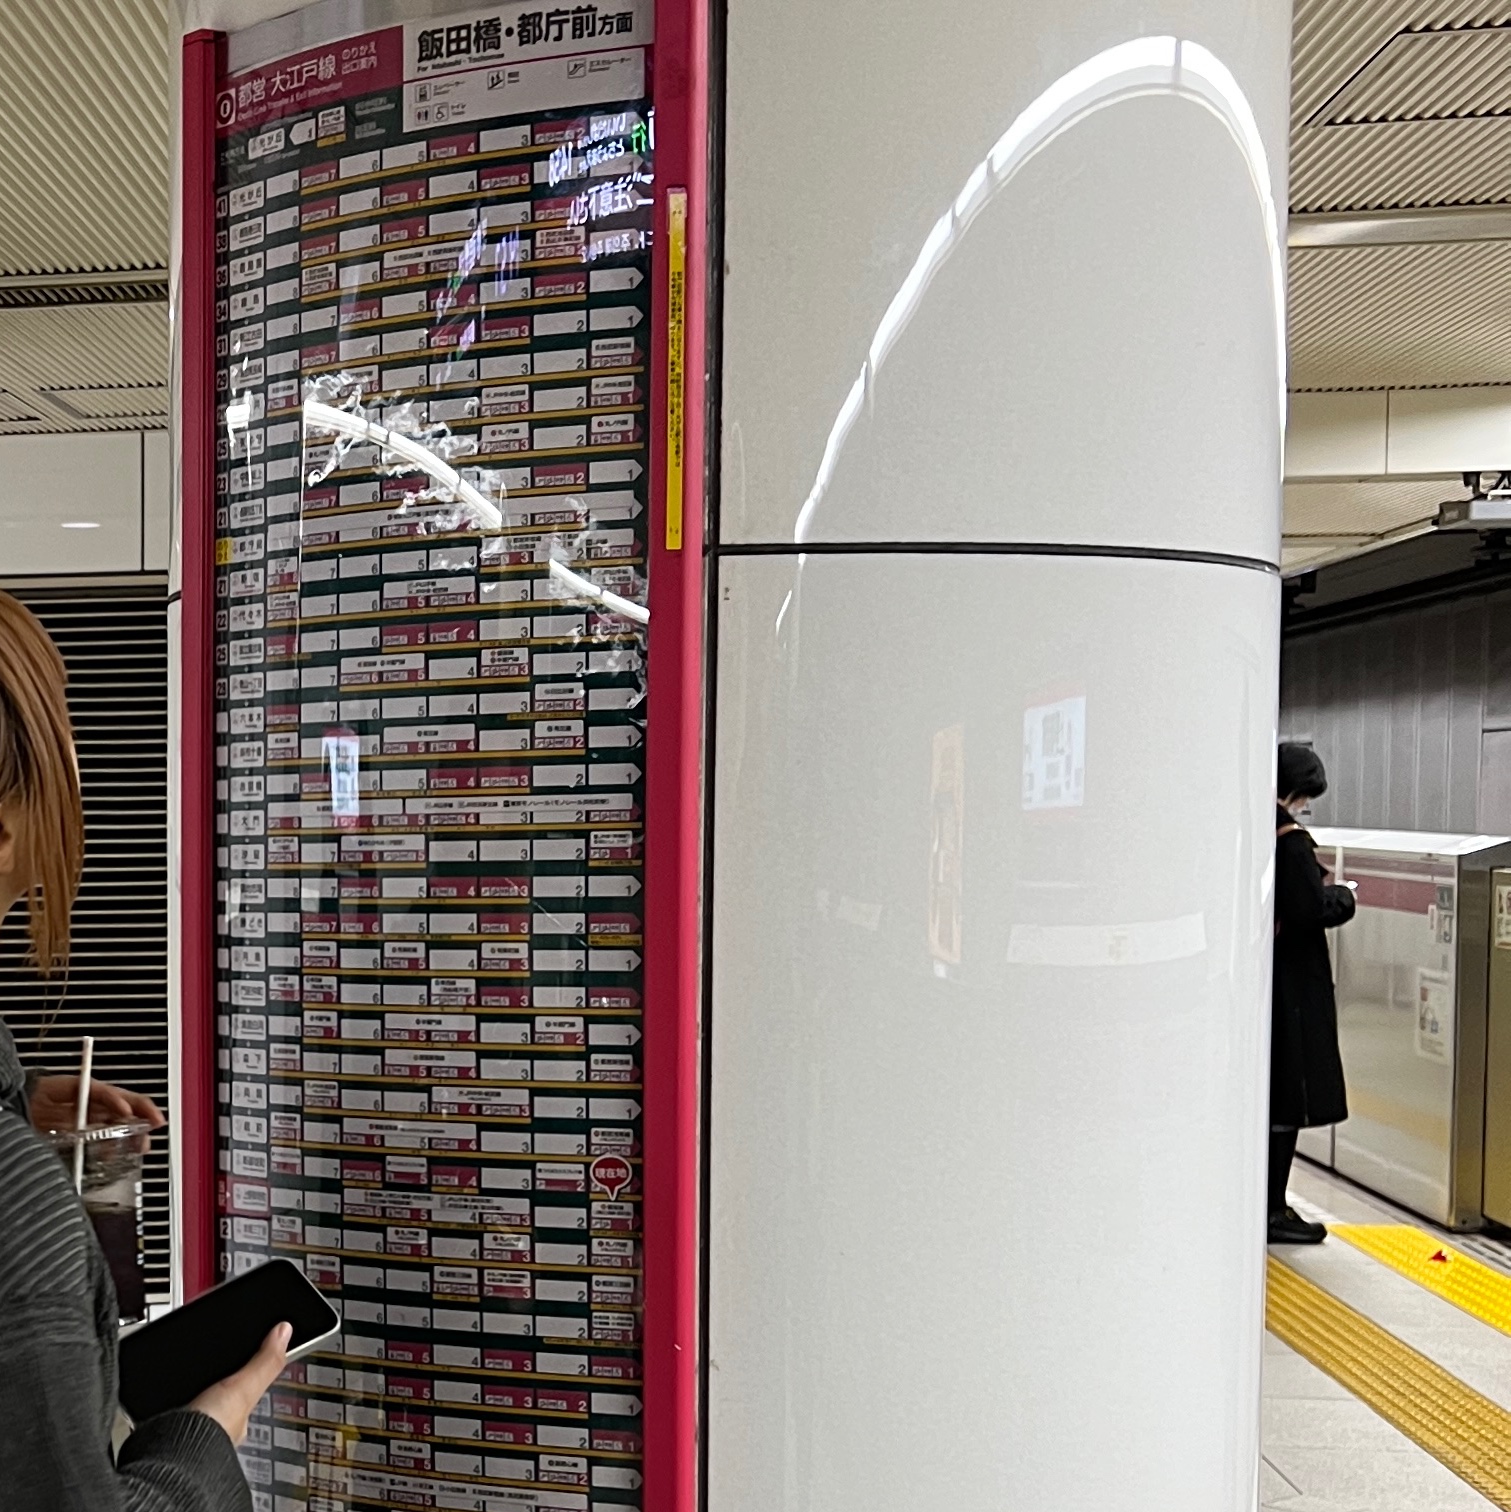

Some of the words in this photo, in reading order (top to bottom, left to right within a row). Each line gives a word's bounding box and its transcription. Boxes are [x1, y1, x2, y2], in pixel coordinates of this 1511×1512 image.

[417, 4, 633, 63] 飯田橋・都庁前方面
[341, 41, 376, 61] のりかえ
[342, 56, 377, 75] 出口案内
[417, 65, 429, 73] For
[238, 76, 266, 108] 都営
[271, 53, 337, 97] 大江戸線
[308, 81, 343, 98] Information
[329, 168, 336, 181] 7
[467, 142, 475, 153] 4
[329, 204, 336, 217] 7
[417, 187, 425, 200] 5
[329, 241, 336, 254] 7
[417, 225, 425, 237] 5
[417, 263, 425, 274] 5
[576, 281, 585, 293] 2
[628, 276, 634, 288] 1
[217, 303, 226, 320] 34
[521, 325, 529, 337] 3
[628, 315, 633, 326] 1
[217, 372, 227, 389] 29
[468, 368, 475, 379] 4
[520, 401, 529, 413] 3
[627, 392, 633, 403] 1
[520, 439, 529, 450] 3
[627, 431, 633, 442] 1
[217, 476, 226, 493] 23
[330, 495, 336, 507] 7
[628, 469, 633, 480] 1
[219, 509, 227, 527] 21
[329, 531, 336, 543] 7
[520, 551, 529, 563] 3
[467, 593, 475, 603] 4
[417, 632, 425, 644] 5
[467, 629, 475, 640] 4
[417, 669, 425, 680] 5
[467, 667, 475, 677] 4
[467, 703, 474, 714] 4
[575, 736, 584, 748] 2
[627, 734, 632, 745] 1
[467, 777, 475, 787] 4
[626, 772, 632, 783] 1
[241, 814, 260, 827] 大門
[467, 813, 475, 824] 4
[468, 850, 474, 860] 4
[625, 848, 631, 858] 1
[467, 886, 475, 896] 4
[626, 885, 631, 895] 1
[372, 921, 380, 933] 6
[520, 922, 528, 933] 3
[468, 959, 475, 969] 4
[626, 959, 631, 970] 1
[468, 995, 476, 1006] 4
[520, 995, 529, 1007] 3
[468, 1031, 476, 1042] 4
[626, 1034, 631, 1044] 1
[419, 1066, 426, 1077] 5
[468, 1067, 476, 1078] 4
[468, 1104, 476, 1114] 4
[627, 1108, 632, 1119] 1
[469, 1140, 477, 1150] 4
[374, 1170, 382, 1181] 6
[467, 1176, 477, 1186] 4
[595, 1167, 627, 1179] 現在地
[469, 1212, 477, 1222] 4
[522, 1214, 530, 1226] 3
[222, 1221, 229, 1236] 2
[421, 1245, 428, 1256] 5
[627, 1257, 632, 1267] 1
[523, 1288, 531, 1299] 3
[577, 1290, 586, 1302] 2
[471, 1320, 478, 1330] 4
[627, 1330, 633, 1341] 1
[471, 1356, 479, 1366] 4
[523, 1360, 532, 1371] 3
[524, 1396, 532, 1408] 3
[628, 1404, 634, 1414] 1
[423, 1423, 431, 1434] 5
[524, 1432, 533, 1444] 3
[473, 1464, 480, 1474] 4
[629, 1478, 634, 1488] 1
[473, 1500, 481, 1510] 4
